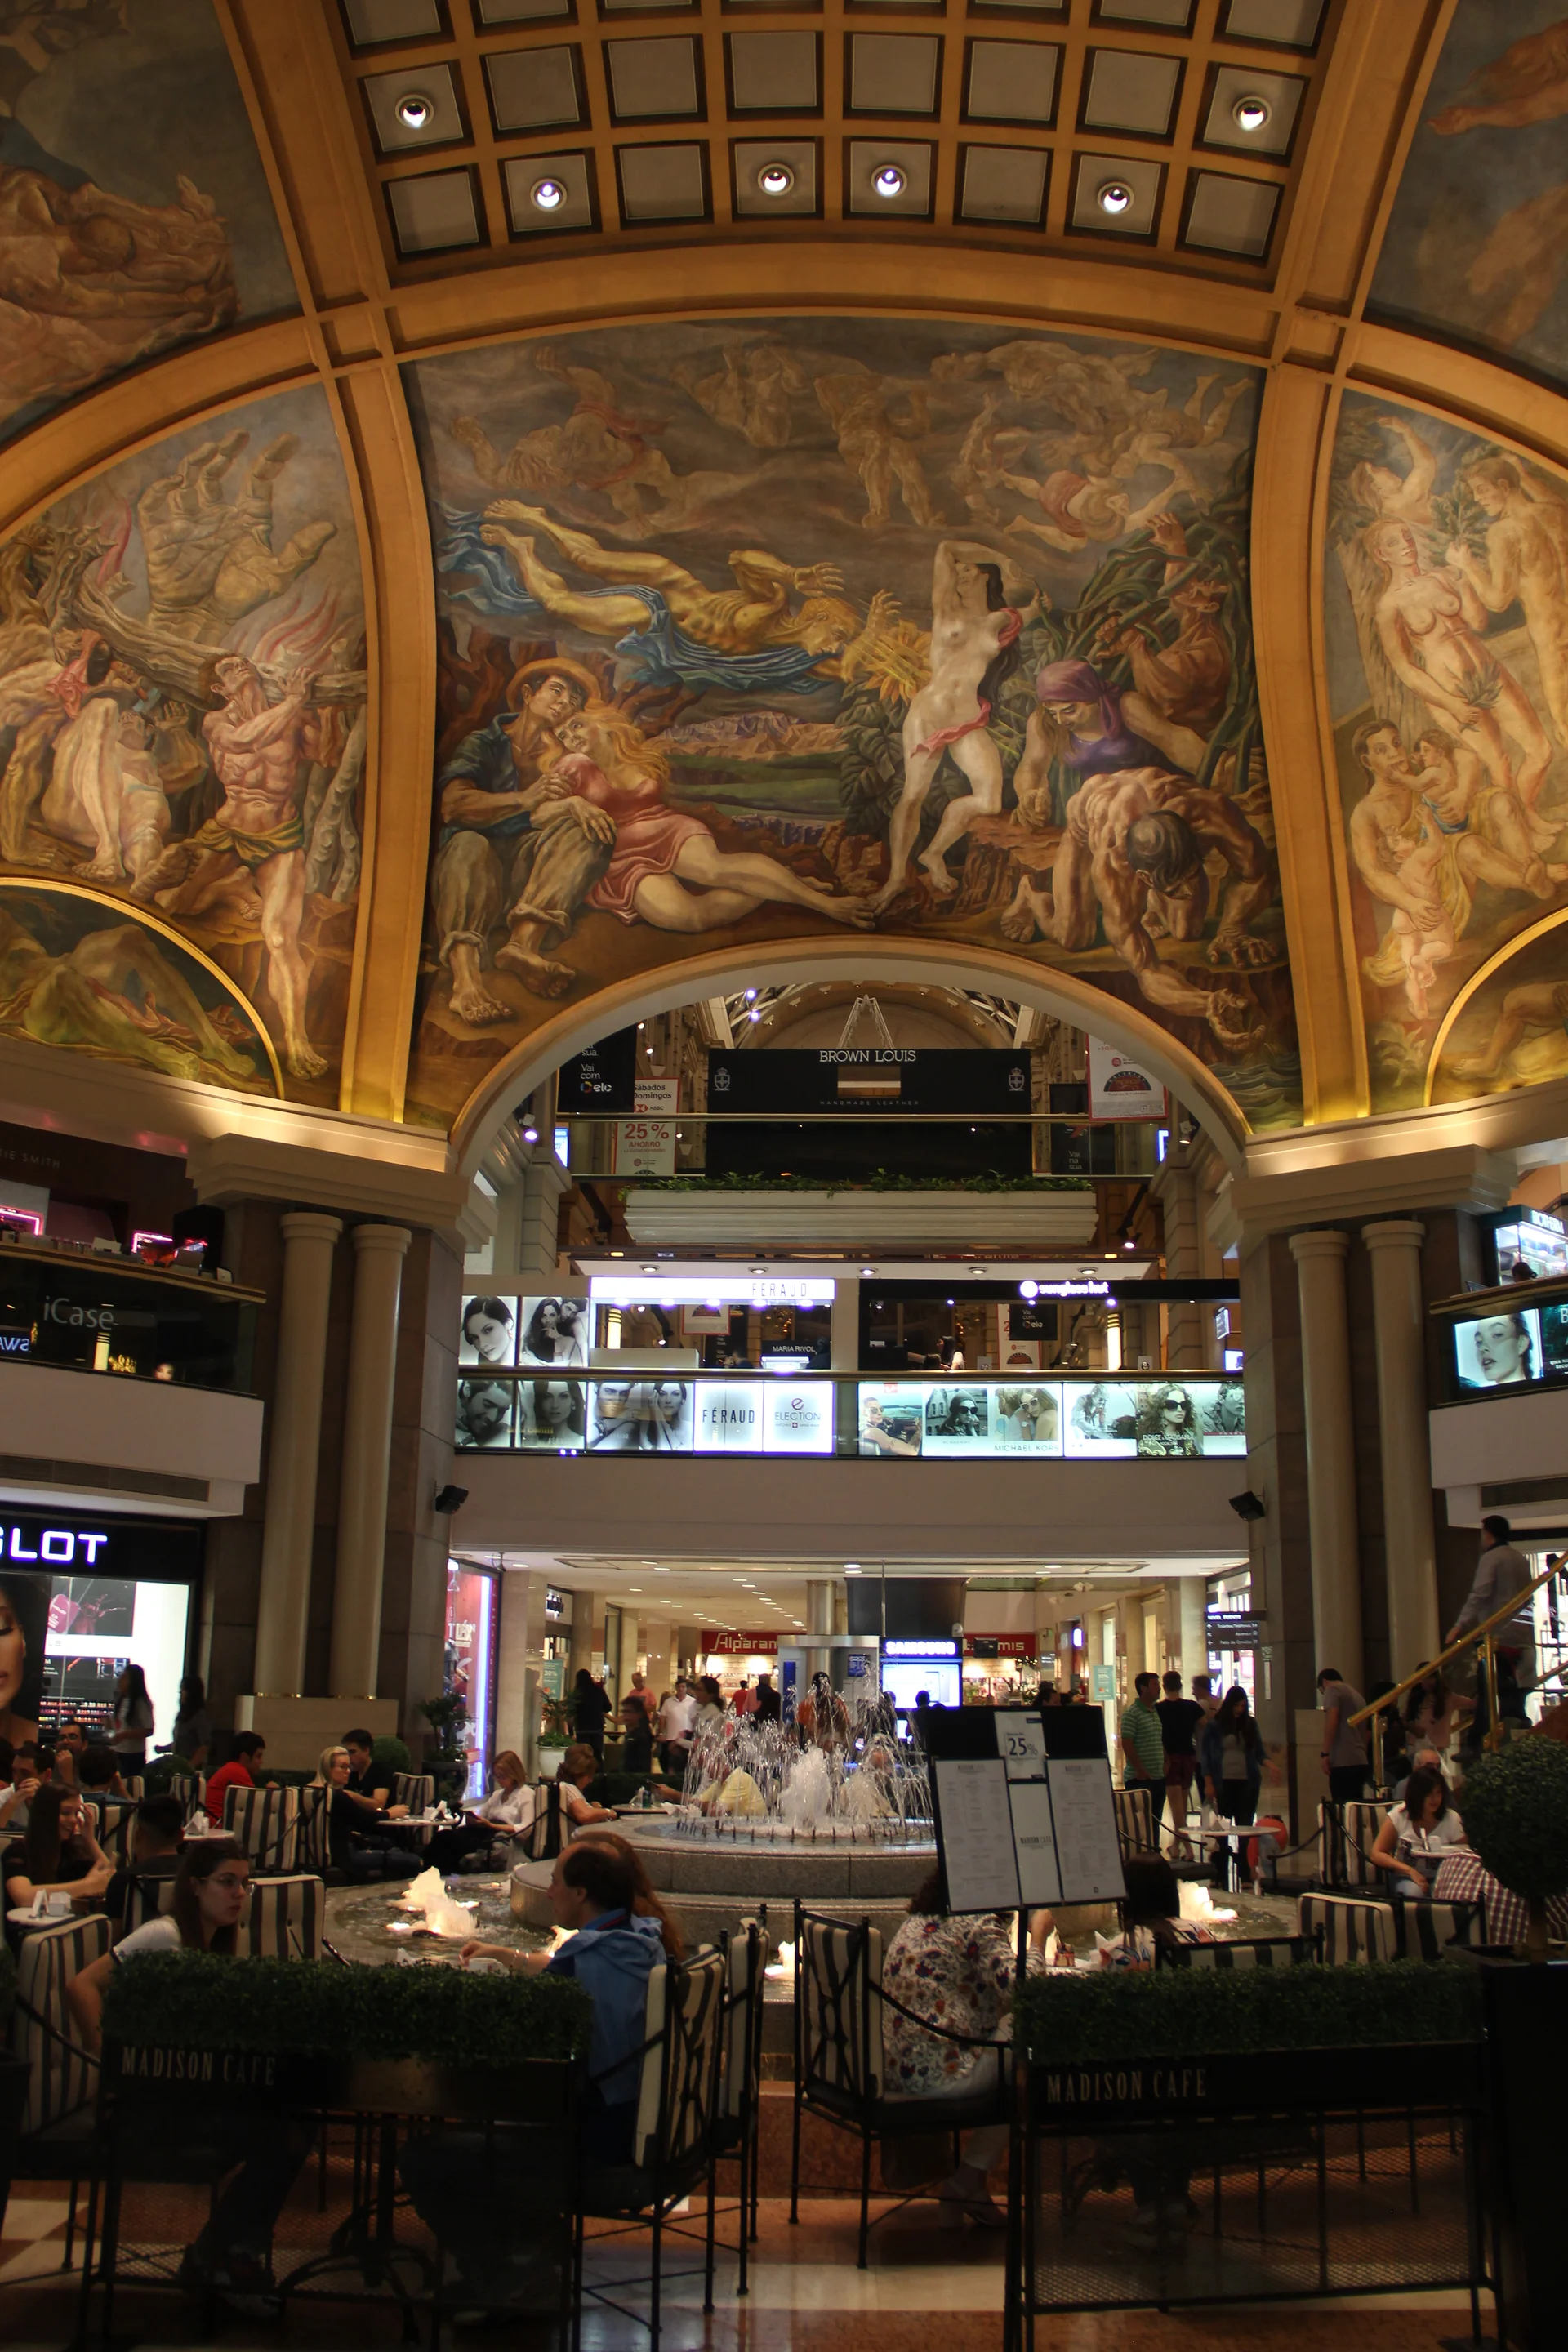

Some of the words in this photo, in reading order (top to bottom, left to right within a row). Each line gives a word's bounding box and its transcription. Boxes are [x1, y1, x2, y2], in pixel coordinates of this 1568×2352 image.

[819, 1050, 869, 1062] BROWN
[875, 1050, 917, 1062] LOUIS
[581, 1063, 595, 1071] Vai
[580, 1071, 601, 1080] com
[634, 1092, 672, 1101] Domingos
[22, 1152, 60, 1169] SMITH
[1039, 1281, 1088, 1297] sunglass
[1088, 1281, 1110, 1294] hut
[43, 1295, 114, 1331] iCase
[702, 1407, 755, 1423] FÉRAUD
[774, 1411, 821, 1420] ELECTION
[885, 1641, 956, 1655] SAMSUNG
[122, 2045, 213, 2082] MADISON
[222, 2052, 275, 2086] CAFE
[1046, 2069, 1143, 2104] MADISON
[1152, 2067, 1207, 2099] CAFE
